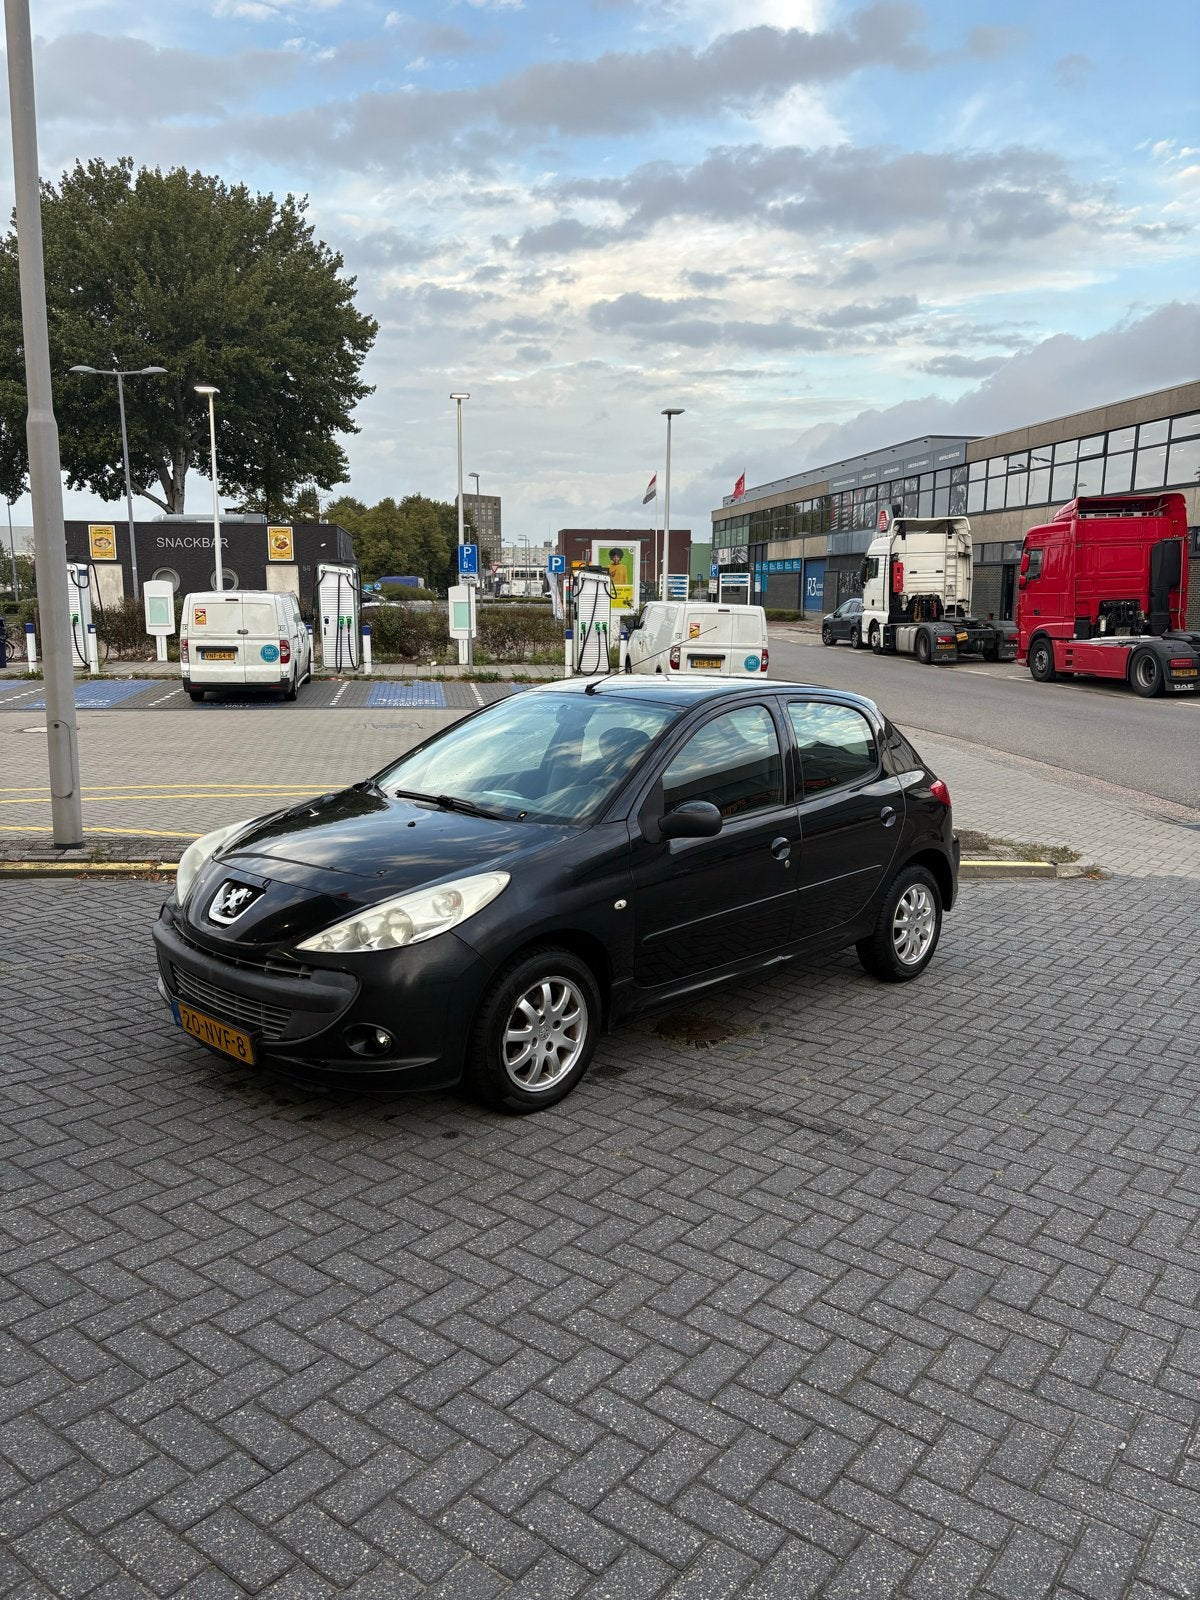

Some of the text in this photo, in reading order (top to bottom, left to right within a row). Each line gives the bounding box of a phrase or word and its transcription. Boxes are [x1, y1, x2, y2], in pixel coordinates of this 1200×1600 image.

[156, 537, 229, 548] SNACKBAR
[463, 547, 472, 558] P
[551, 557, 561, 571] P
[182, 1009, 247, 1058] 20-NVF-8
